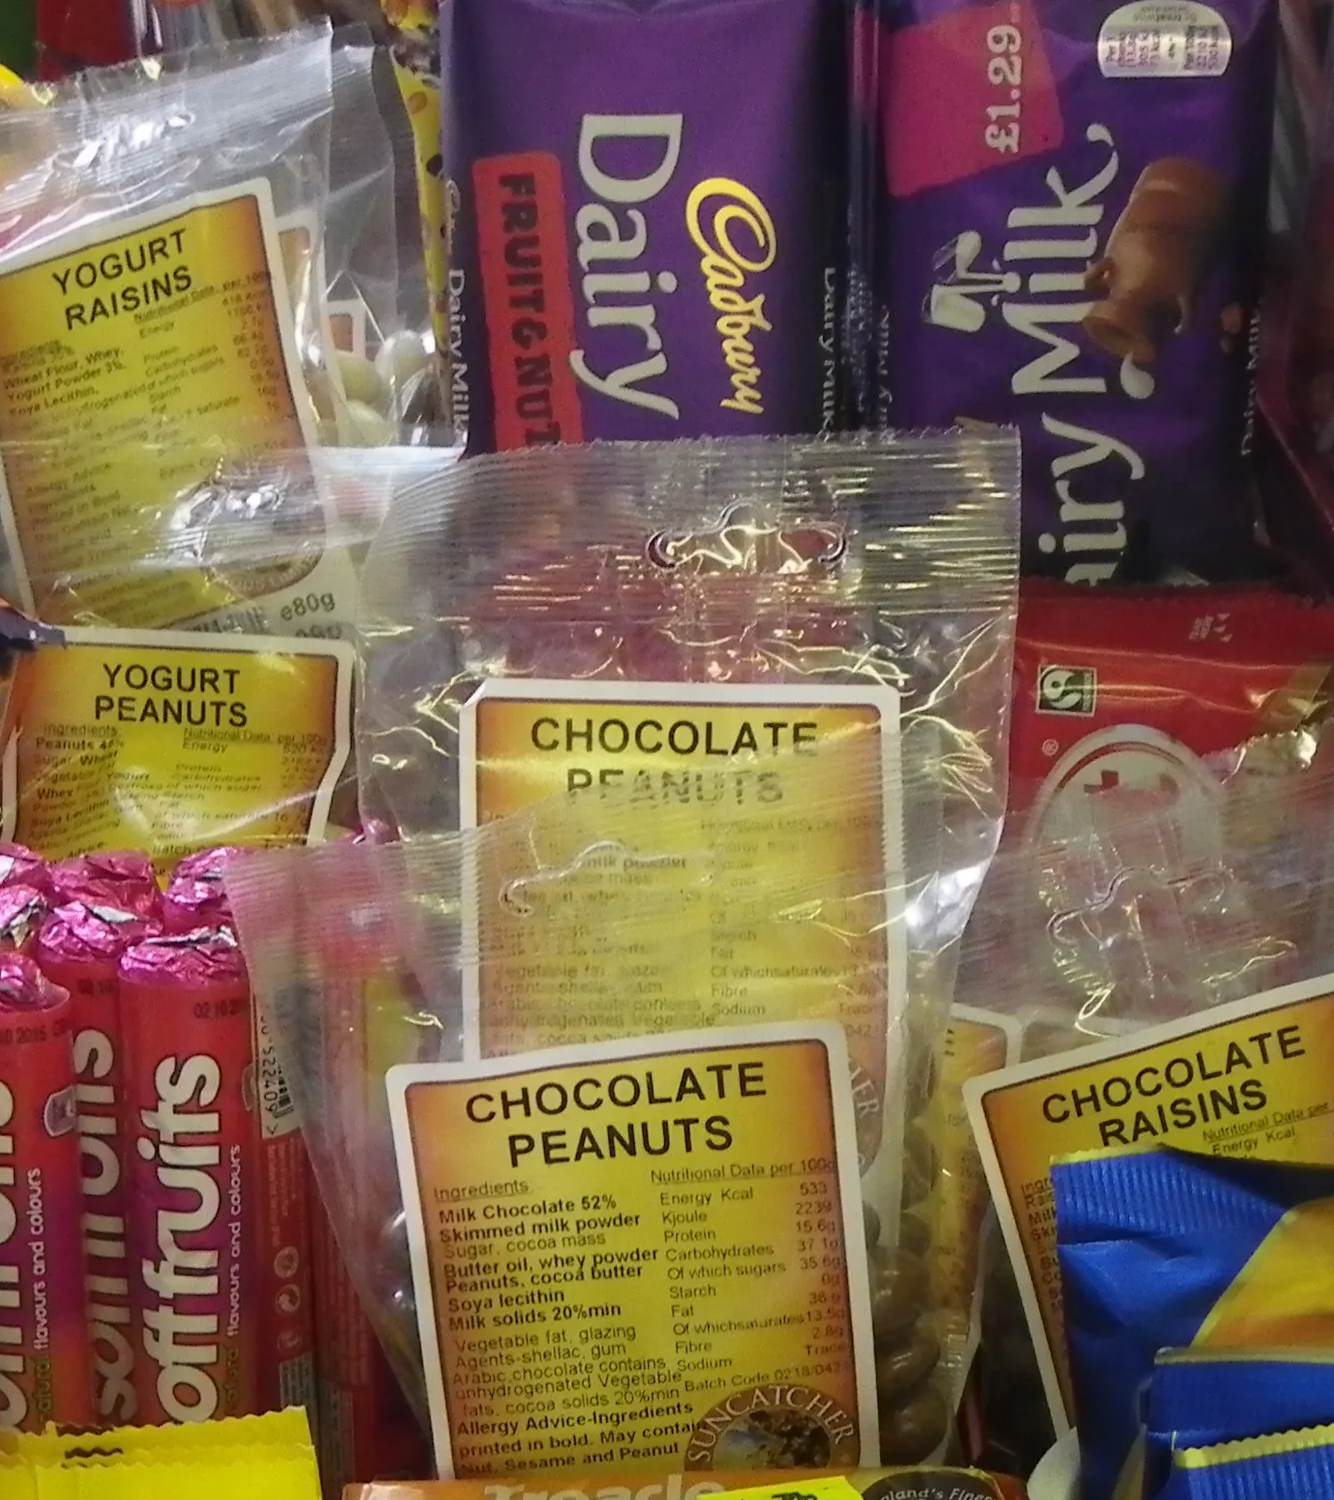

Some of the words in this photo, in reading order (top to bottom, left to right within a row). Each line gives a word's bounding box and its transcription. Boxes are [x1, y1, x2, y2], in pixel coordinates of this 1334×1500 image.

[985, 24, 1021, 154] £1.29
[499, 173, 546, 311] FRUIT
[52, 228, 187, 297] YOGURT
[570, 113, 683, 421] Dairy
[65, 265, 193, 330] RAISINS
[687, 178, 777, 414] Cadbury
[515, 356, 560, 445] NUT
[280, 590, 336, 621] e80g
[103, 664, 241, 694] YOGURT
[94, 695, 248, 728] PEANUTS
[531, 717, 820, 760] CHOCOLATE
[567, 767, 785, 807] PEANUTS
[465, 1060, 767, 1125] CHOCOLATE
[1042, 1024, 1306, 1124] CHOCOLATE
[1099, 1079, 1268, 1147] RAISINS
[507, 1115, 734, 1169] PEANUTS
[28, 1167, 43, 1235] colours
[439, 1209, 476, 1224] Milk
[483, 1199, 575, 1220] Chocolate
[581, 1194, 616, 1211] 52%
[660, 1190, 713, 1208] Energy
[720, 1187, 754, 1202] Kcal
[440, 1222, 525, 1244] Skimmed
[531, 1218, 570, 1234] milk
[576, 1213, 641, 1235] powder
[664, 1228, 717, 1244] Protein
[32, 1241, 45, 1272] and
[665, 1242, 774, 1264] Carbohydrates
[530, 1267, 585, 1286] cocoa
[591, 1264, 643, 1281] butter
[669, 1286, 717, 1300] Starch
[33, 1276, 48, 1350] flavours
[671, 1304, 695, 1317] Fat
[675, 1339, 713, 1355] Fibre
[677, 1356, 732, 1372] Sodium
[456, 1419, 518, 1436] Allergy
[687, 1384, 855, 1464] SUNCATCHER
